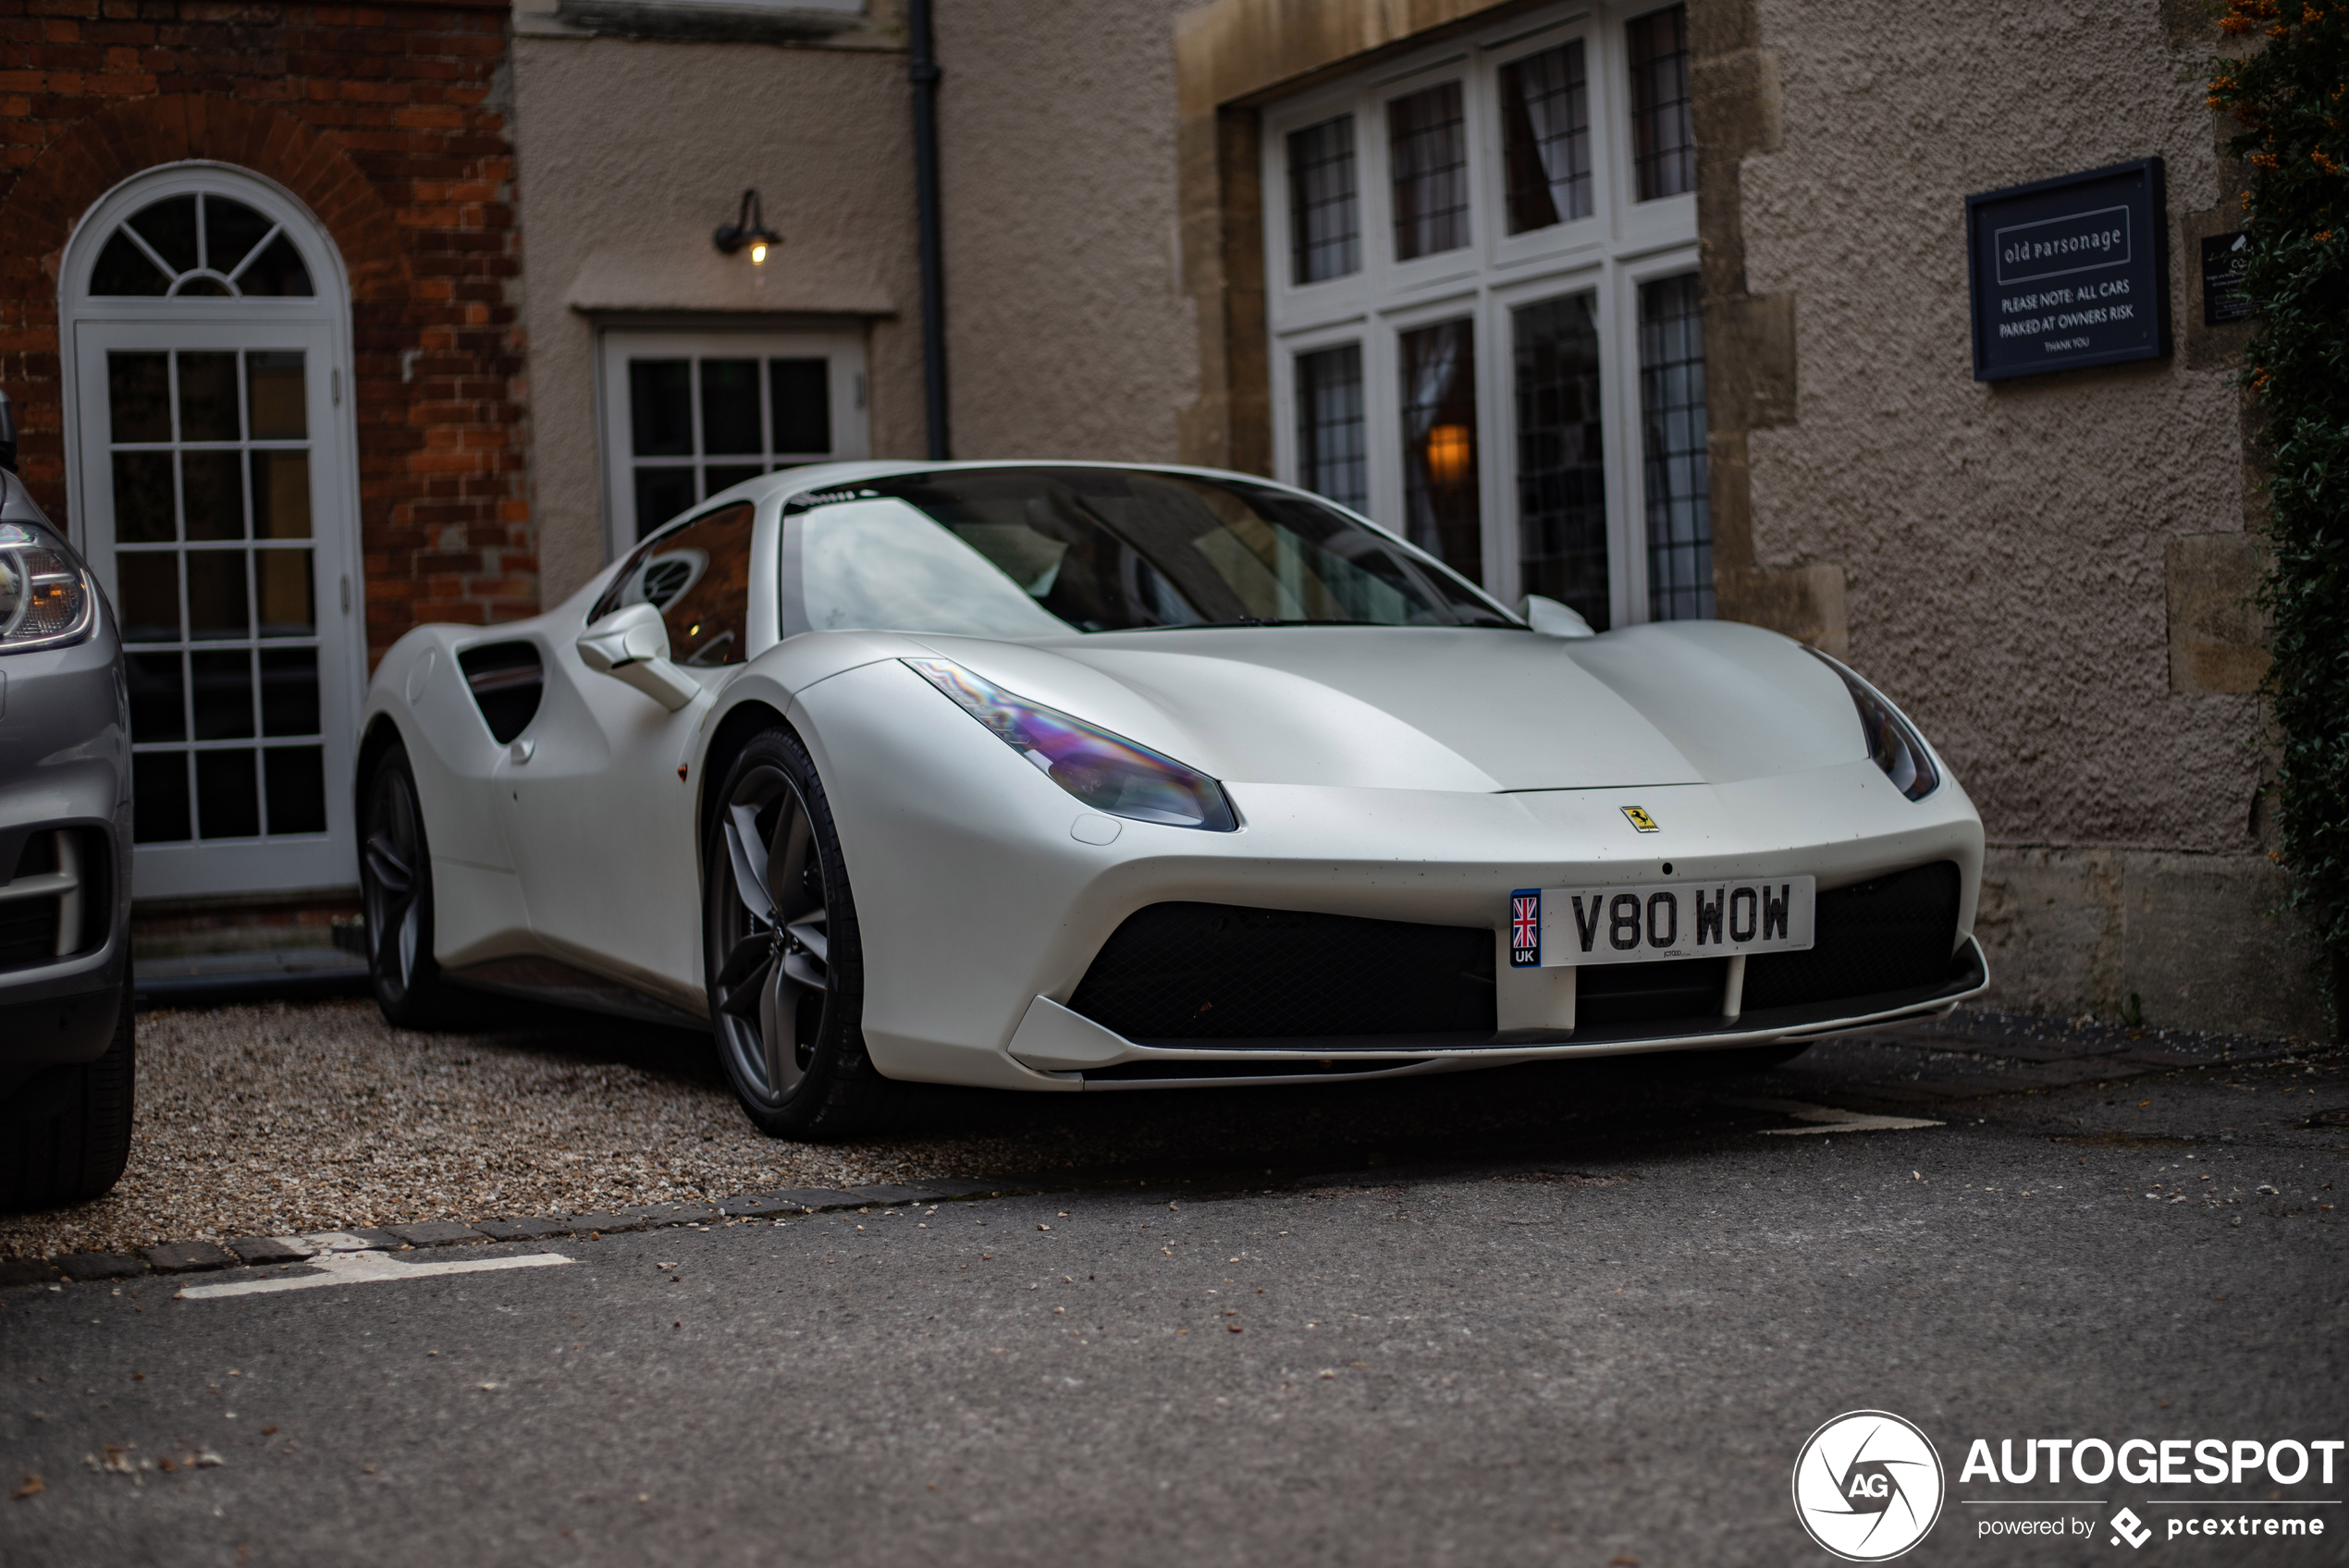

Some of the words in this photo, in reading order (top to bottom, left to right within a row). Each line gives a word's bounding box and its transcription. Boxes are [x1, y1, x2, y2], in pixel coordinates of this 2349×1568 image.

[2004, 241, 2030, 263] old
[2001, 295, 2037, 313] PLEASE
[2039, 288, 2073, 308] NOTE:
[2076, 285, 2097, 301] ALL
[2099, 279, 2130, 298] CARS
[1998, 319, 2040, 338] PARKED
[2041, 316, 2055, 332] AT
[2057, 308, 2108, 329] OWNERS
[2109, 304, 2134, 322] RISK
[2044, 339, 2072, 353] THANK
[2072, 337, 2089, 349] YOU
[1571, 891, 1678, 952] V80
[1695, 884, 1790, 946] WOW
[1515, 949, 1534, 962] UK
